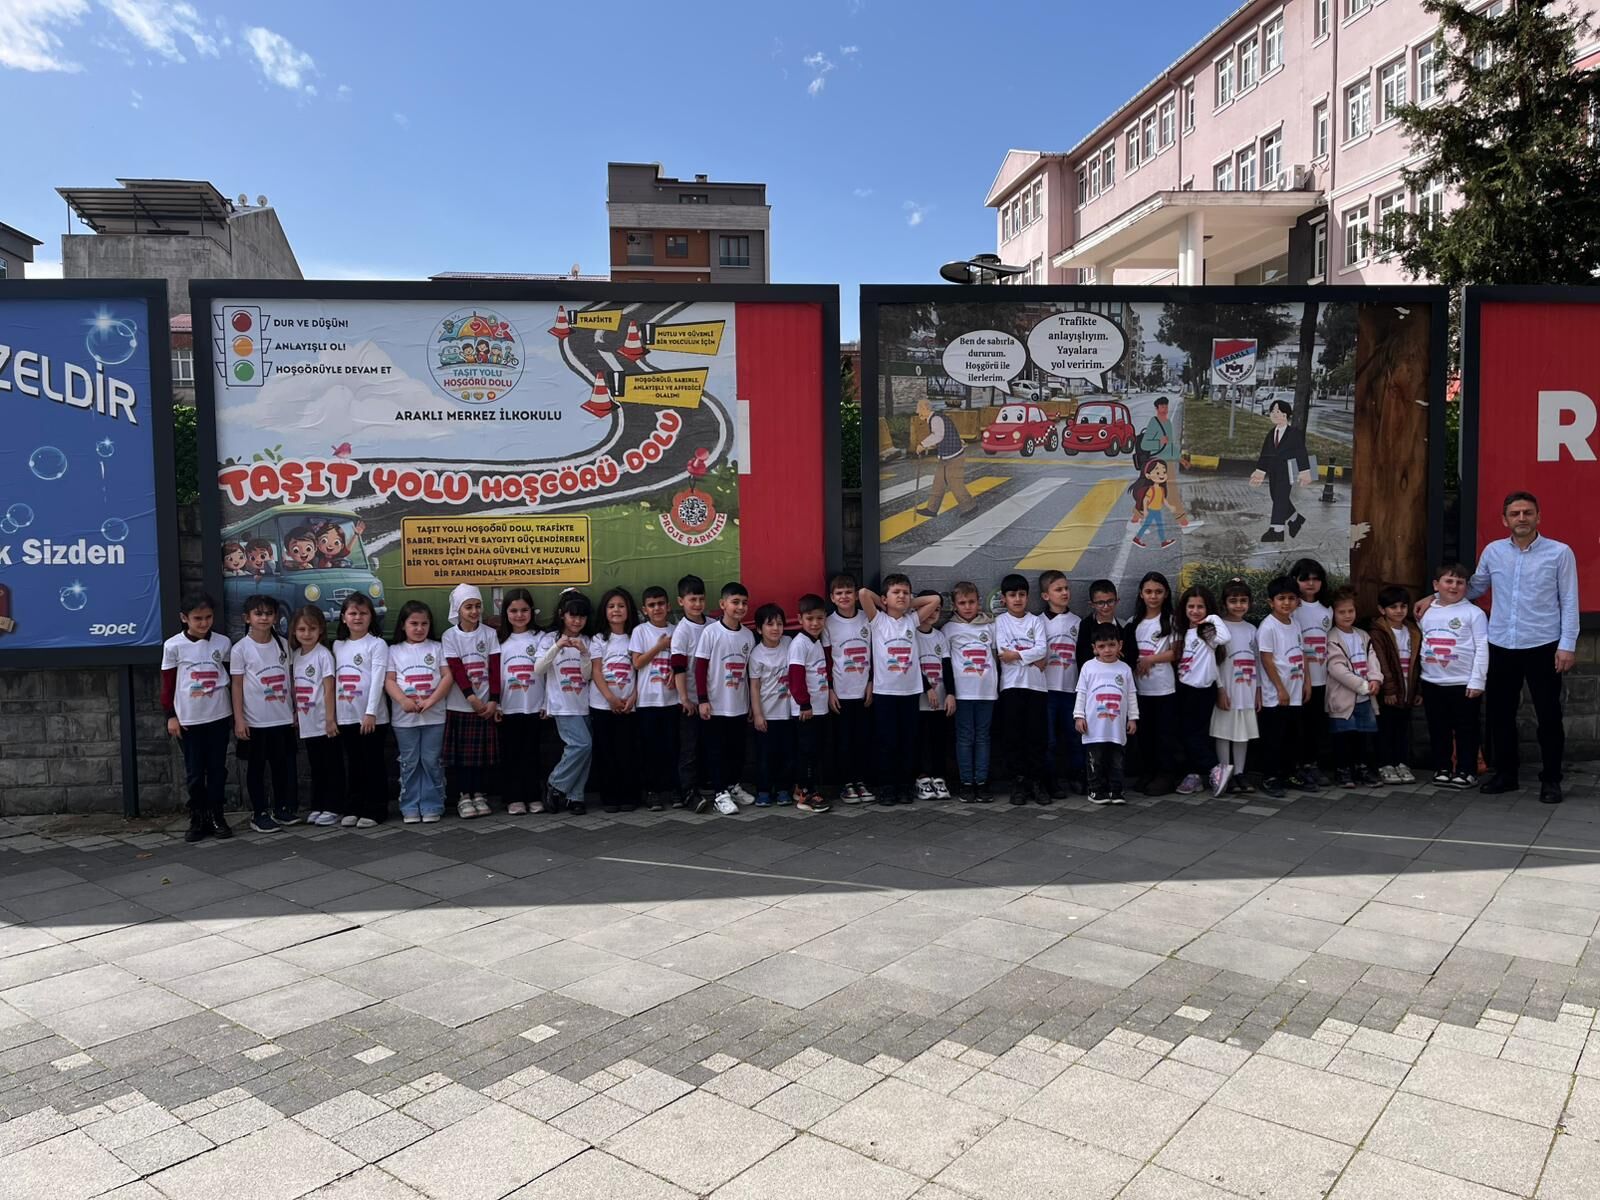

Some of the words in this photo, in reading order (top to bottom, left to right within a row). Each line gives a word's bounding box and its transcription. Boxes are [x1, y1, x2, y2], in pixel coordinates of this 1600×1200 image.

[274, 320, 294, 328] DUR
[312, 318, 348, 330] DÜŞÜN!
[1058, 316, 1096, 326] Trafikte
[1048, 331, 1108, 343] anlayışlıyım.
[275, 343, 326, 352] ANLAYIŞLI
[1057, 346, 1098, 356] Yayalara
[968, 349, 1006, 357] dururum.
[276, 364, 342, 376] HOŞGÖRÜYLE
[966, 361, 998, 372] Hoşgörü
[1000, 361, 1010, 370] ile
[1051, 360, 1065, 370] yol
[1067, 360, 1104, 368] veririm.
[453, 368, 478, 377] TAŞIT
[480, 369, 502, 378] YOLU
[968, 374, 1006, 382] ilerlerim.
[444, 377, 486, 387] HOŞGÖRÜ
[489, 379, 512, 388] DOLU
[395, 410, 443, 420] ARAKLI
[446, 410, 496, 420] MERKEZ
[500, 408, 562, 420] İLKOKULU
[218, 461, 358, 503] TAŞIT
[372, 467, 469, 500] YOLU
[482, 458, 618, 504] HOŞGÖRÜ
[626, 412, 680, 471] DOLU
[417, 526, 440, 534] TAŞIT
[466, 523, 507, 534] HOŞGÖRÜ
[536, 523, 574, 532] TRAFİKTE
[661, 514, 685, 542] PROJE
[686, 514, 725, 546] ŞARKIMIZ
[437, 535, 466, 544] EMPATİ
[517, 534, 584, 544] GÜÇLENDİREREK
[22, 538, 125, 565] Sizden
[446, 546, 465, 556] İÇİN
[493, 546, 528, 554] GÜVENLİ
[407, 558, 422, 566] BİR
[476, 558, 533, 566] OLUŞTURMAYI
[536, 558, 586, 566] AMAÇLAYAN
[434, 568, 448, 576] BİR
[509, 567, 560, 576] PROJESİDİR
[89, 622, 136, 636] opet
